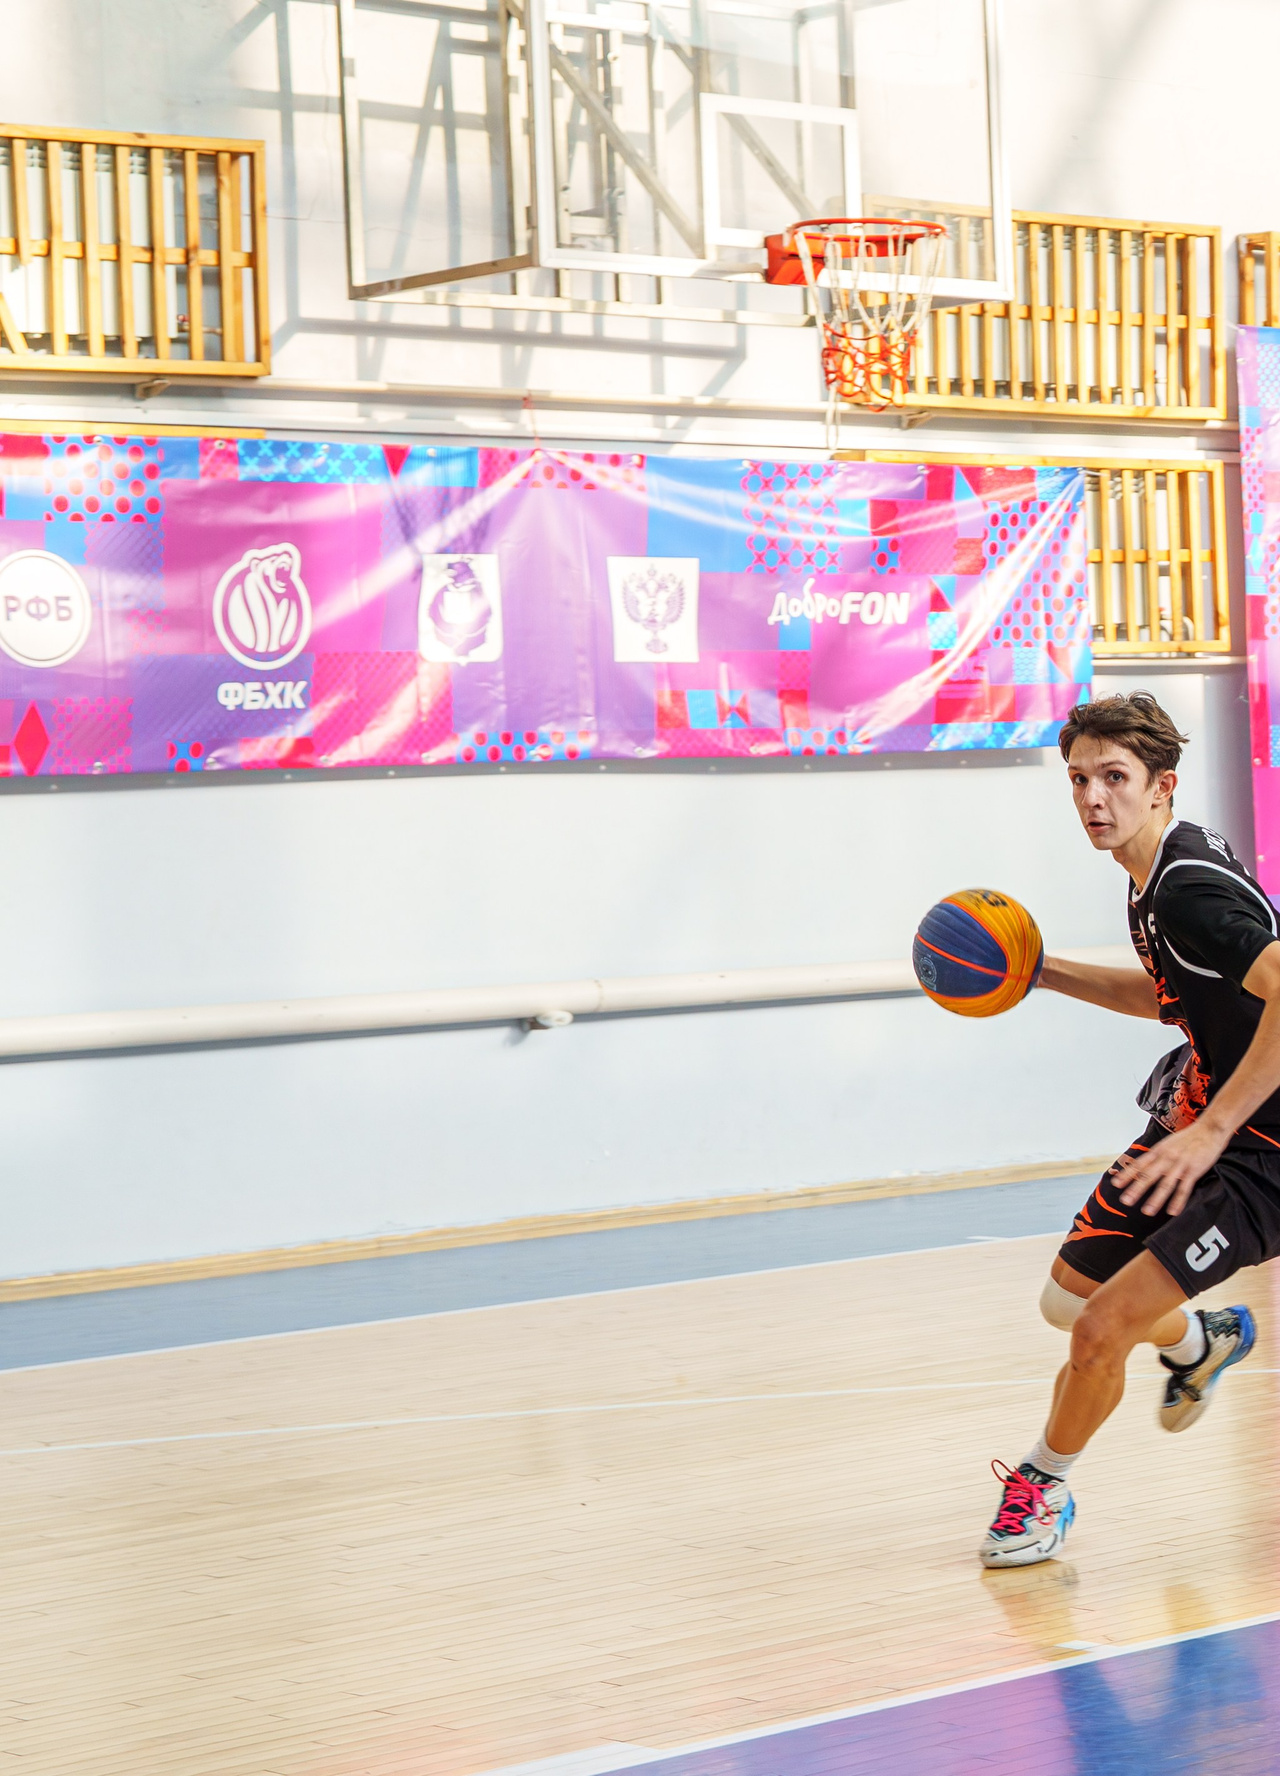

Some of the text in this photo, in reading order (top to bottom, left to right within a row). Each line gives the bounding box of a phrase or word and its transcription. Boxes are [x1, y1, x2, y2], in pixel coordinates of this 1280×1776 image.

[3, 595, 73, 622] РФБ
[216, 680, 308, 712] ФБХК
[1184, 1225, 1231, 1273] 5
